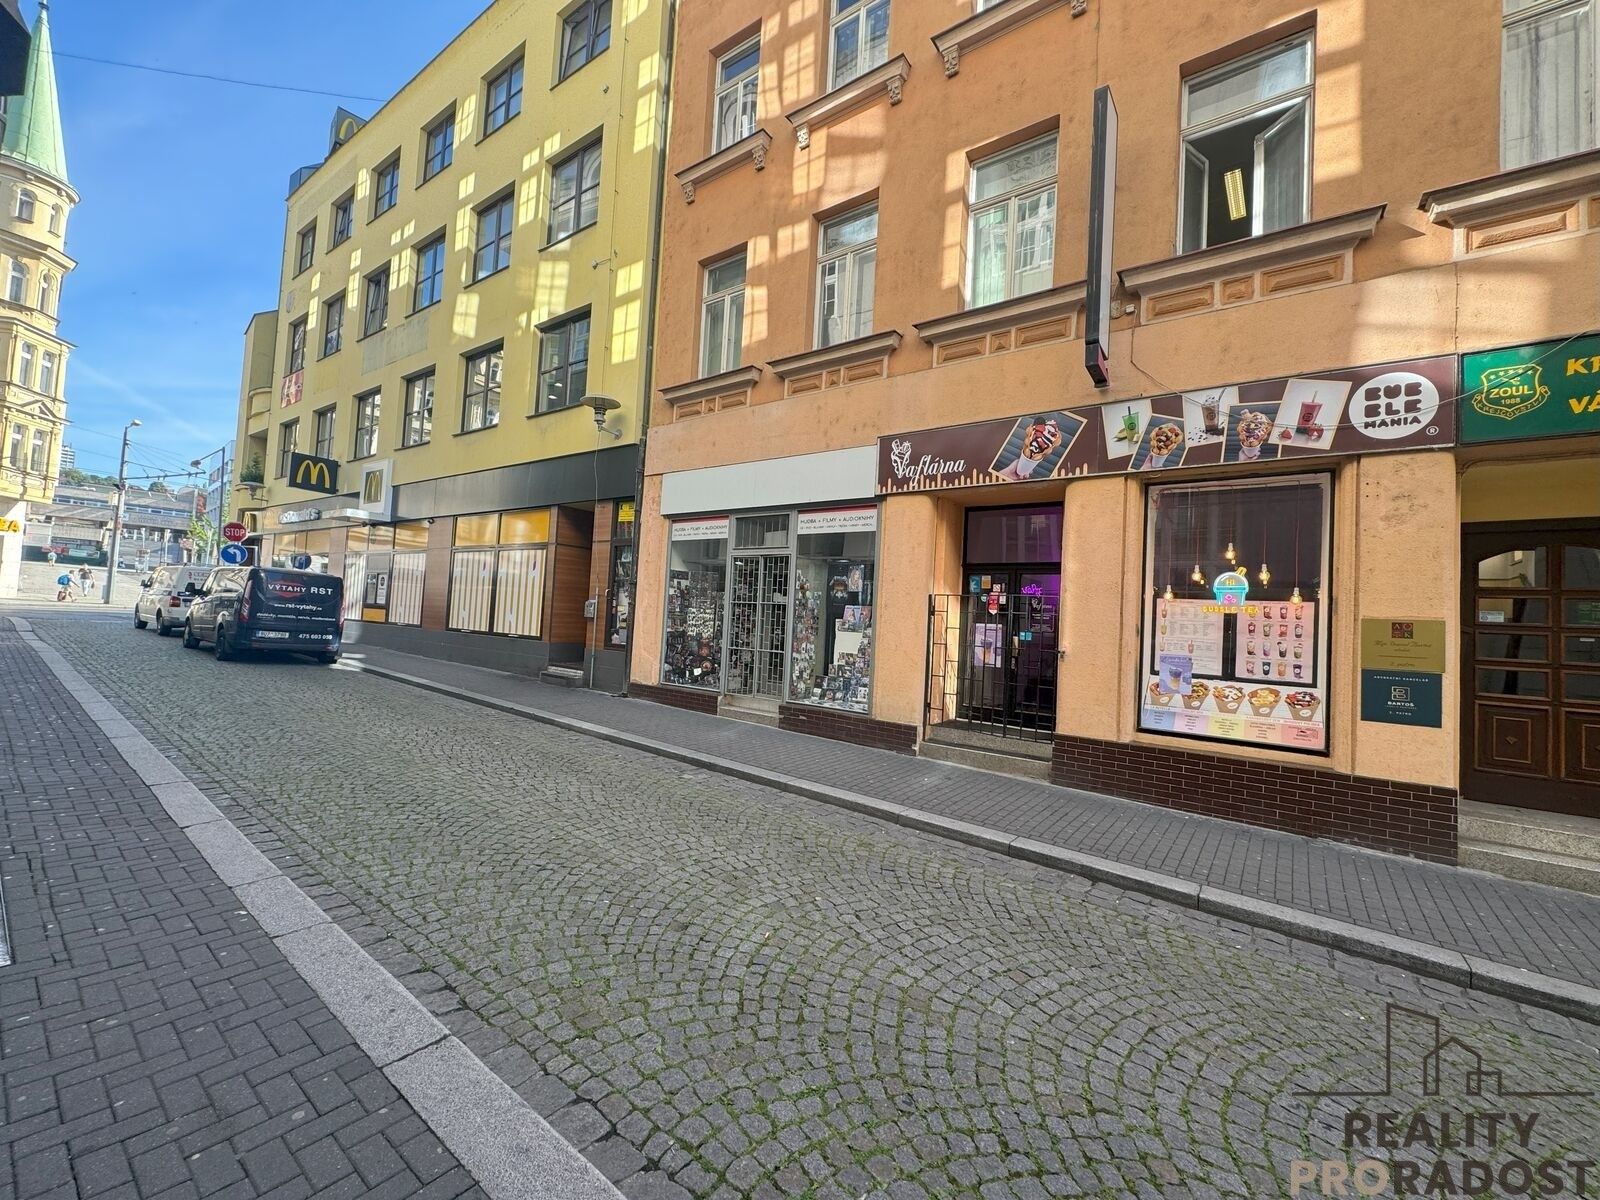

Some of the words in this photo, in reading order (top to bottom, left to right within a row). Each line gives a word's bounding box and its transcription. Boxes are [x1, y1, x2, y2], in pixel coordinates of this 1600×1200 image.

[1489, 385, 1534, 398] ZOUL
[1364, 416, 1421, 429] MANIA
[892, 453, 967, 487] Vaflárna
[225, 528, 245, 536] STOP
[268, 583, 307, 593] VÝTAHY
[310, 586, 334, 595] RST
